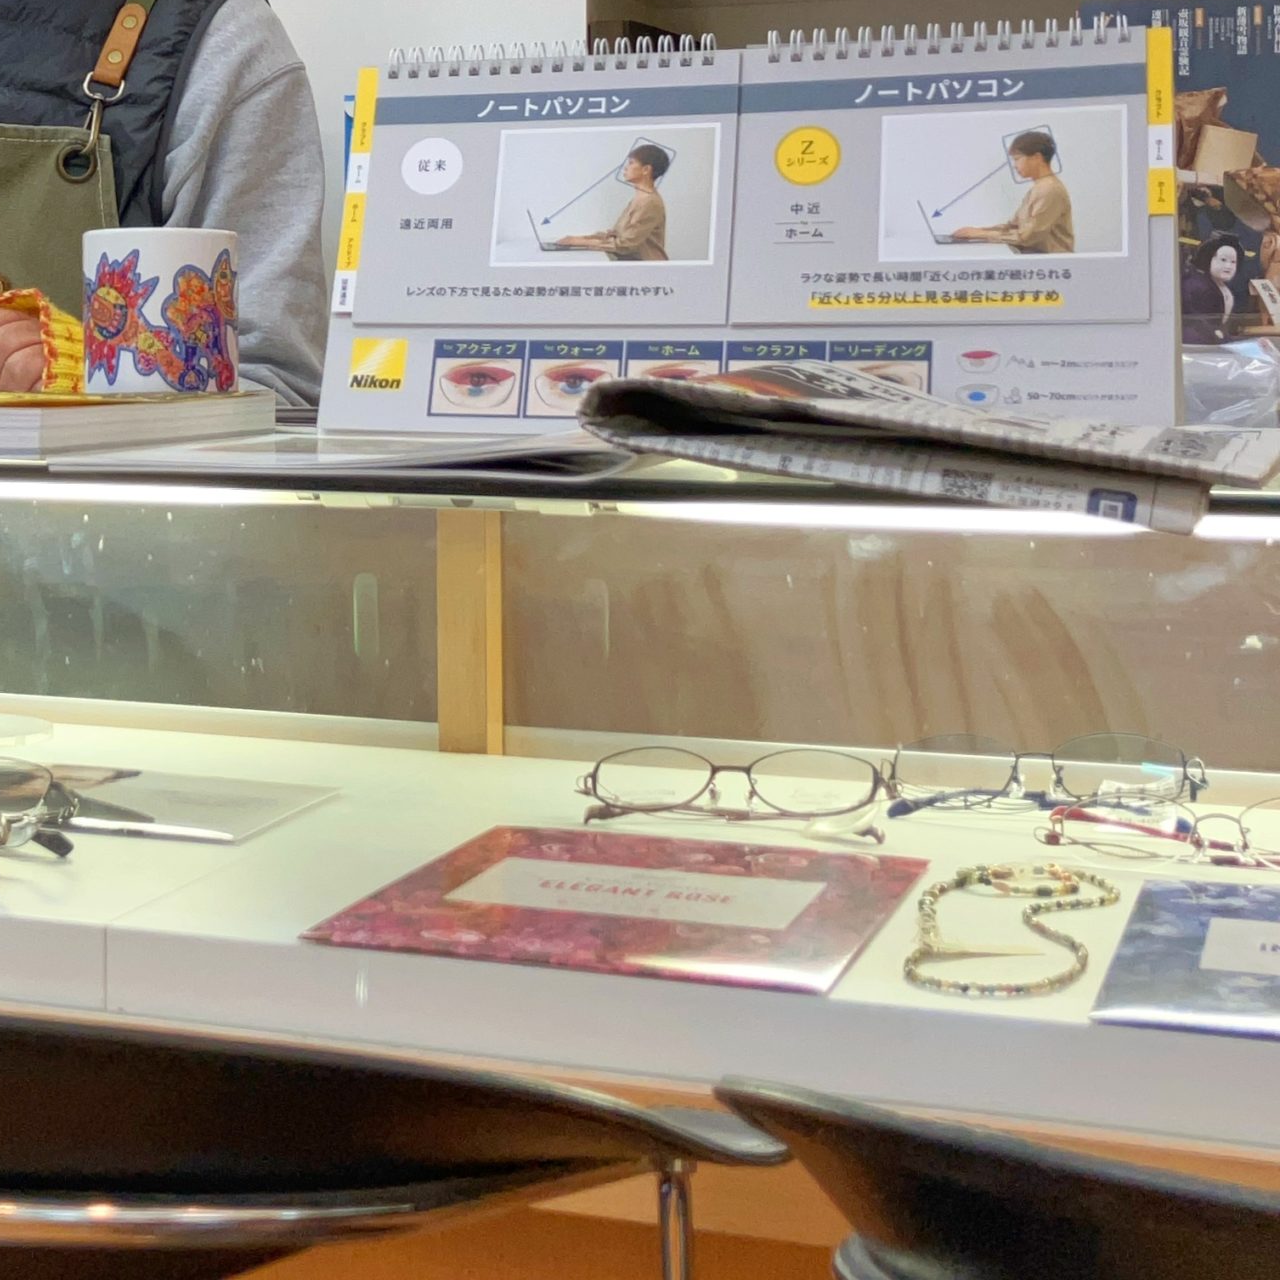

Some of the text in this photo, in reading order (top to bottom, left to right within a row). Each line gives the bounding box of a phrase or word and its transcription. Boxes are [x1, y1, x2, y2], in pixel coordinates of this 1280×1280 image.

[854, 76, 1025, 104] ノートパソコン
[477, 95, 630, 119] ノートパソコン
[801, 140, 815, 154] Z
[417, 159, 447, 173] 従来
[786, 155, 829, 167] シリーズ
[790, 202, 820, 215] 中近
[399, 218, 453, 230] 遠近両用
[785, 228, 823, 239] ホーム
[455, 343, 517, 355] アクティブ
[557, 343, 607, 356] ウォーク
[661, 344, 700, 355] ホーム
[756, 345, 808, 357] クラフト
[848, 343, 927, 357] リーディング
[349, 374, 401, 390] Nikon
[539, 879, 734, 905] ELEGANT ROSE
